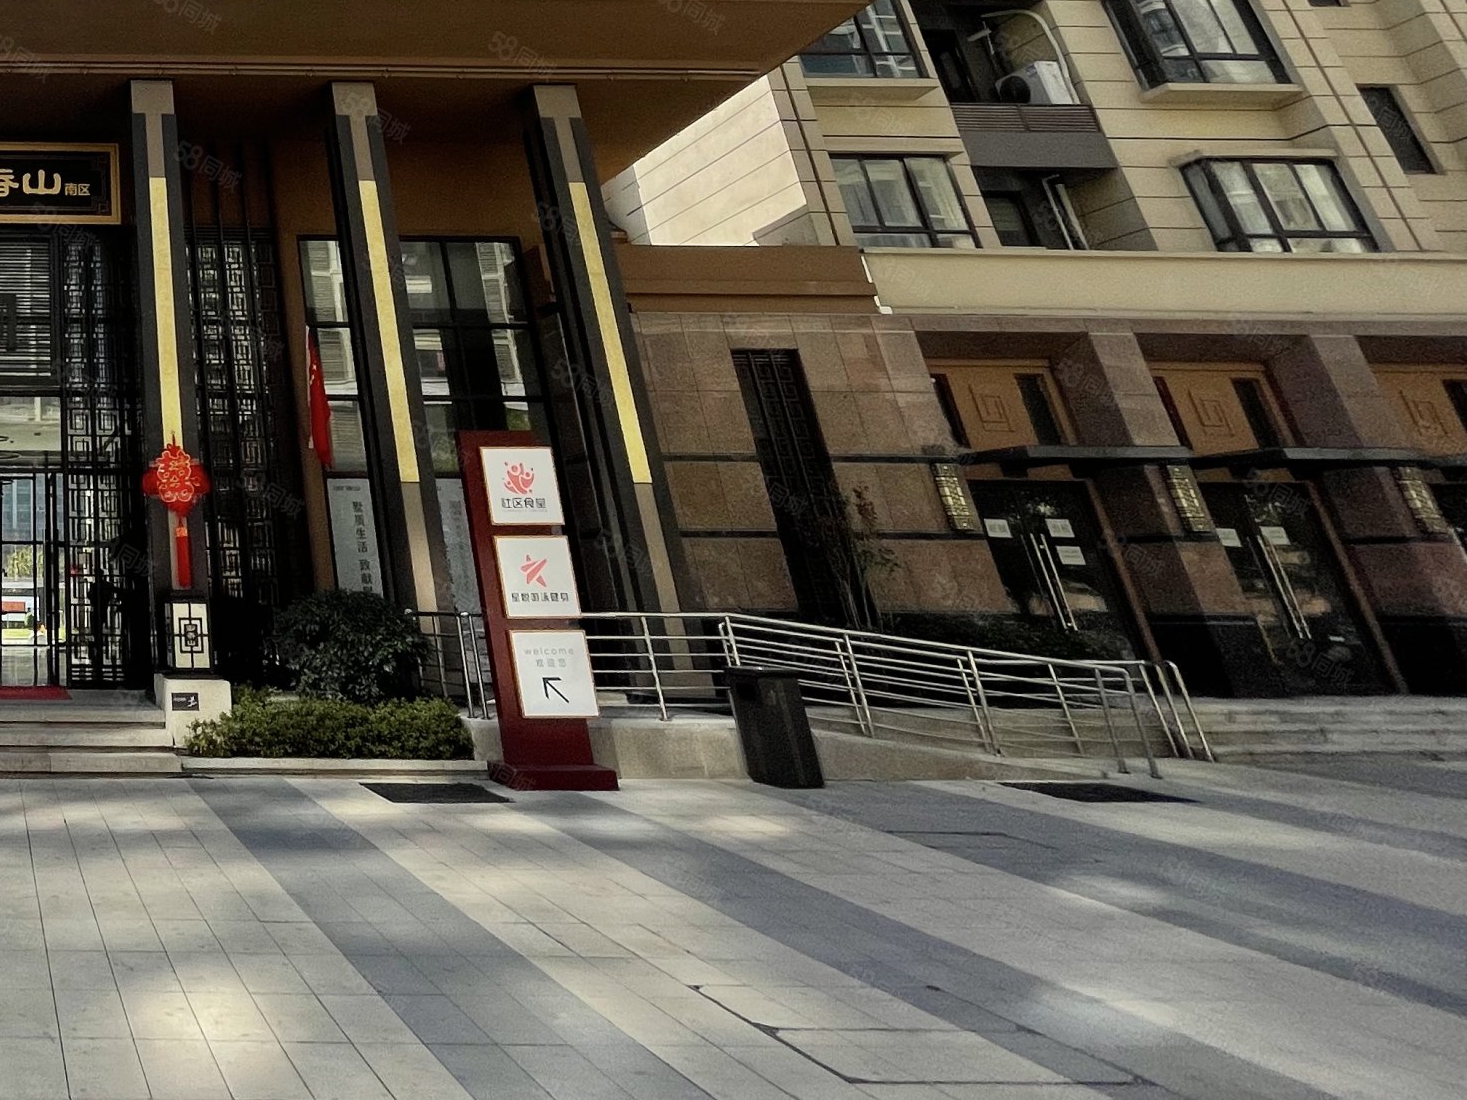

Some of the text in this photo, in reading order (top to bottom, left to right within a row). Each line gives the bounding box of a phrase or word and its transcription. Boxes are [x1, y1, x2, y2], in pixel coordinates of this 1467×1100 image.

[64, 183, 91, 196] 南区
[501, 497, 546, 509] 社区食堂
[524, 647, 575, 655] welcome
